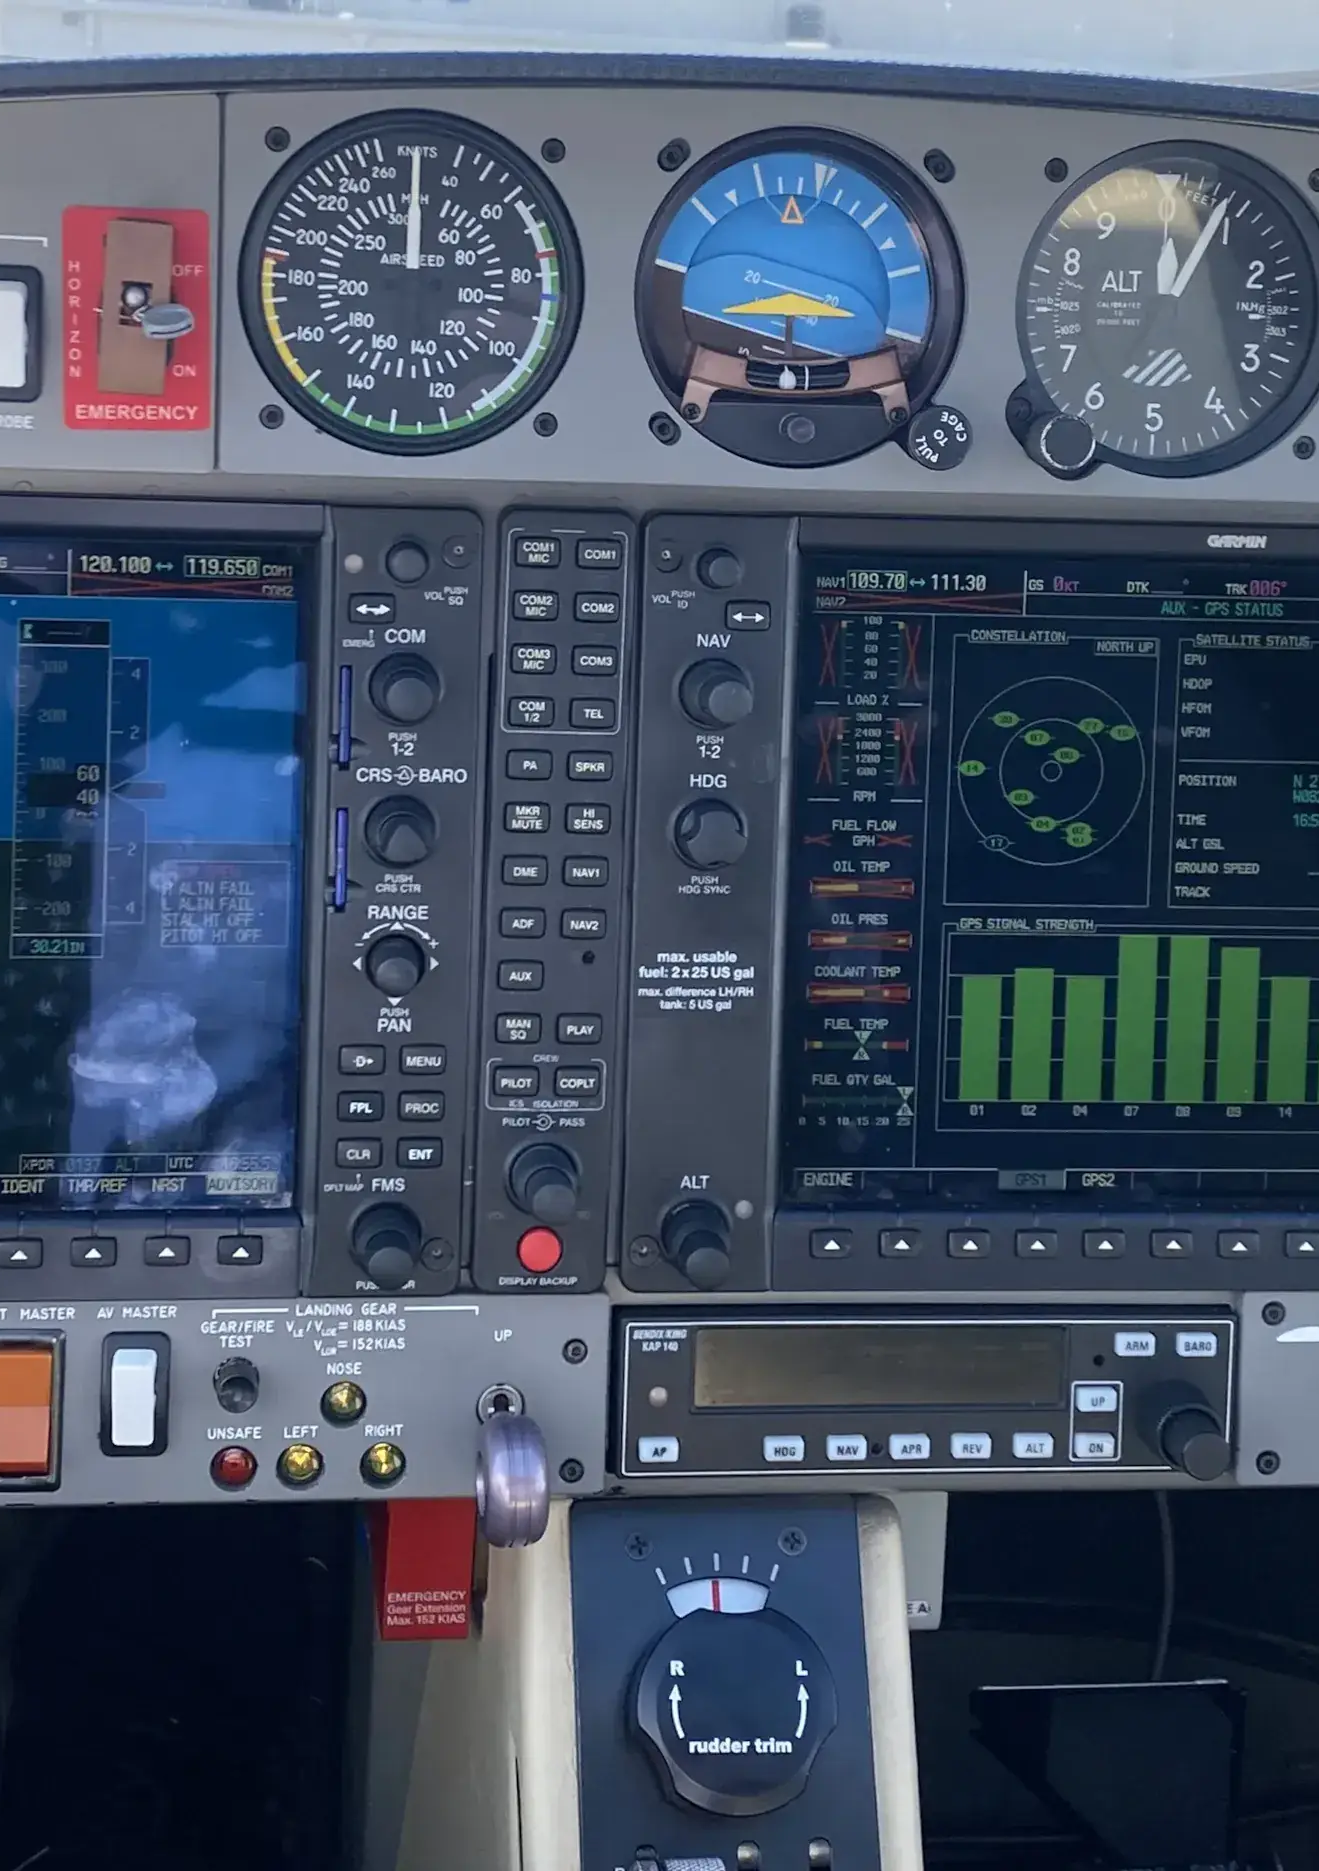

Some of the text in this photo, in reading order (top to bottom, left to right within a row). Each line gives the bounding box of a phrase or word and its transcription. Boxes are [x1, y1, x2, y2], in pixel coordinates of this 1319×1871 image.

[339, 178, 371, 195] 240
[318, 195, 349, 212] 220
[481, 205, 503, 220] 60
[296, 229, 327, 246] 200
[287, 271, 315, 286] 180
[511, 269, 532, 284] 80
[1102, 270, 1140, 292] ALT
[297, 327, 324, 342] 160
[489, 341, 515, 356] 100
[347, 374, 375, 391] 140
[429, 382, 455, 399] 120
[75, 405, 198, 422] EMERGENCY
[80, 556, 259, 577] 120.100 119.650
[850, 575, 906, 590] 109.70
[931, 575, 986, 591] 111.30
[582, 603, 614, 613] COM2
[385, 629, 426, 643] COM
[970, 631, 1066, 642] CONSTELLATION
[1097, 641, 1154, 653] NORTH UP
[584, 709, 604, 719] TEL
[356, 769, 467, 783] CRS BARO
[832, 820, 896, 831] FUEL FLOW
[367, 906, 428, 920] RANGE
[570, 920, 598, 931] NAV2
[960, 918, 1093, 930] GPS SIGNAL STRENGTH
[657, 951, 737, 962] max. usable
[377, 1019, 412, 1032] PAN
[1, 1179, 44, 1194] IDENT
[372, 1179, 405, 1191] FMS
[804, 1173, 853, 1186] ENGINE
[1082, 1173, 1115, 1186] GPS2
[20, 1307, 75, 1321] MASTER
[97, 1306, 176, 1318] AV MASTER
[295, 1303, 397, 1316] LANDING GEAR
[200, 1321, 274, 1334] GEAR/FIRE
[220, 1335, 253, 1348] TEST
[494, 1330, 513, 1342] UP
[327, 1363, 362, 1375] NOSE
[207, 1426, 261, 1440] UNSAFE
[284, 1426, 318, 1437] LEFT
[364, 1424, 403, 1437] RIGHT
[388, 1591, 465, 1602] EMERGENCY
[689, 1738, 792, 1754] rudder trim
